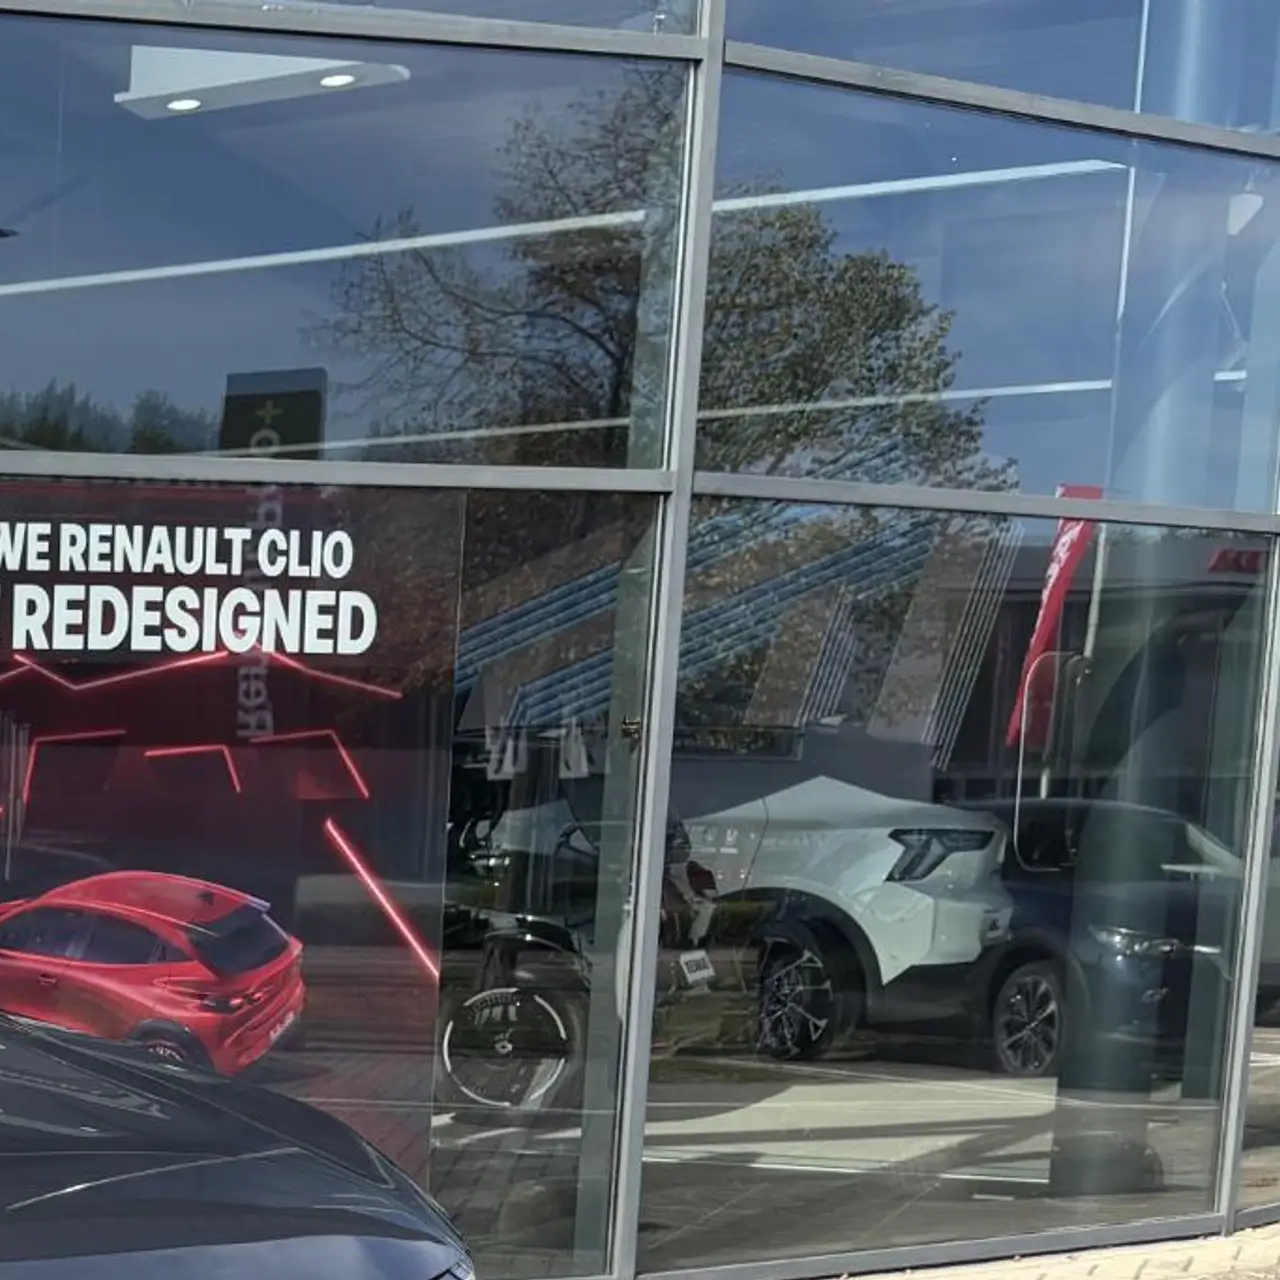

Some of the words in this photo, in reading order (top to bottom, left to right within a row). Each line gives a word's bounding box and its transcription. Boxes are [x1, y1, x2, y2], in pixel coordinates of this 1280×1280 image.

[60, 523, 251, 576] RENAULT
[257, 529, 353, 579] CLIO
[12, 584, 378, 656] REDESIGNED
